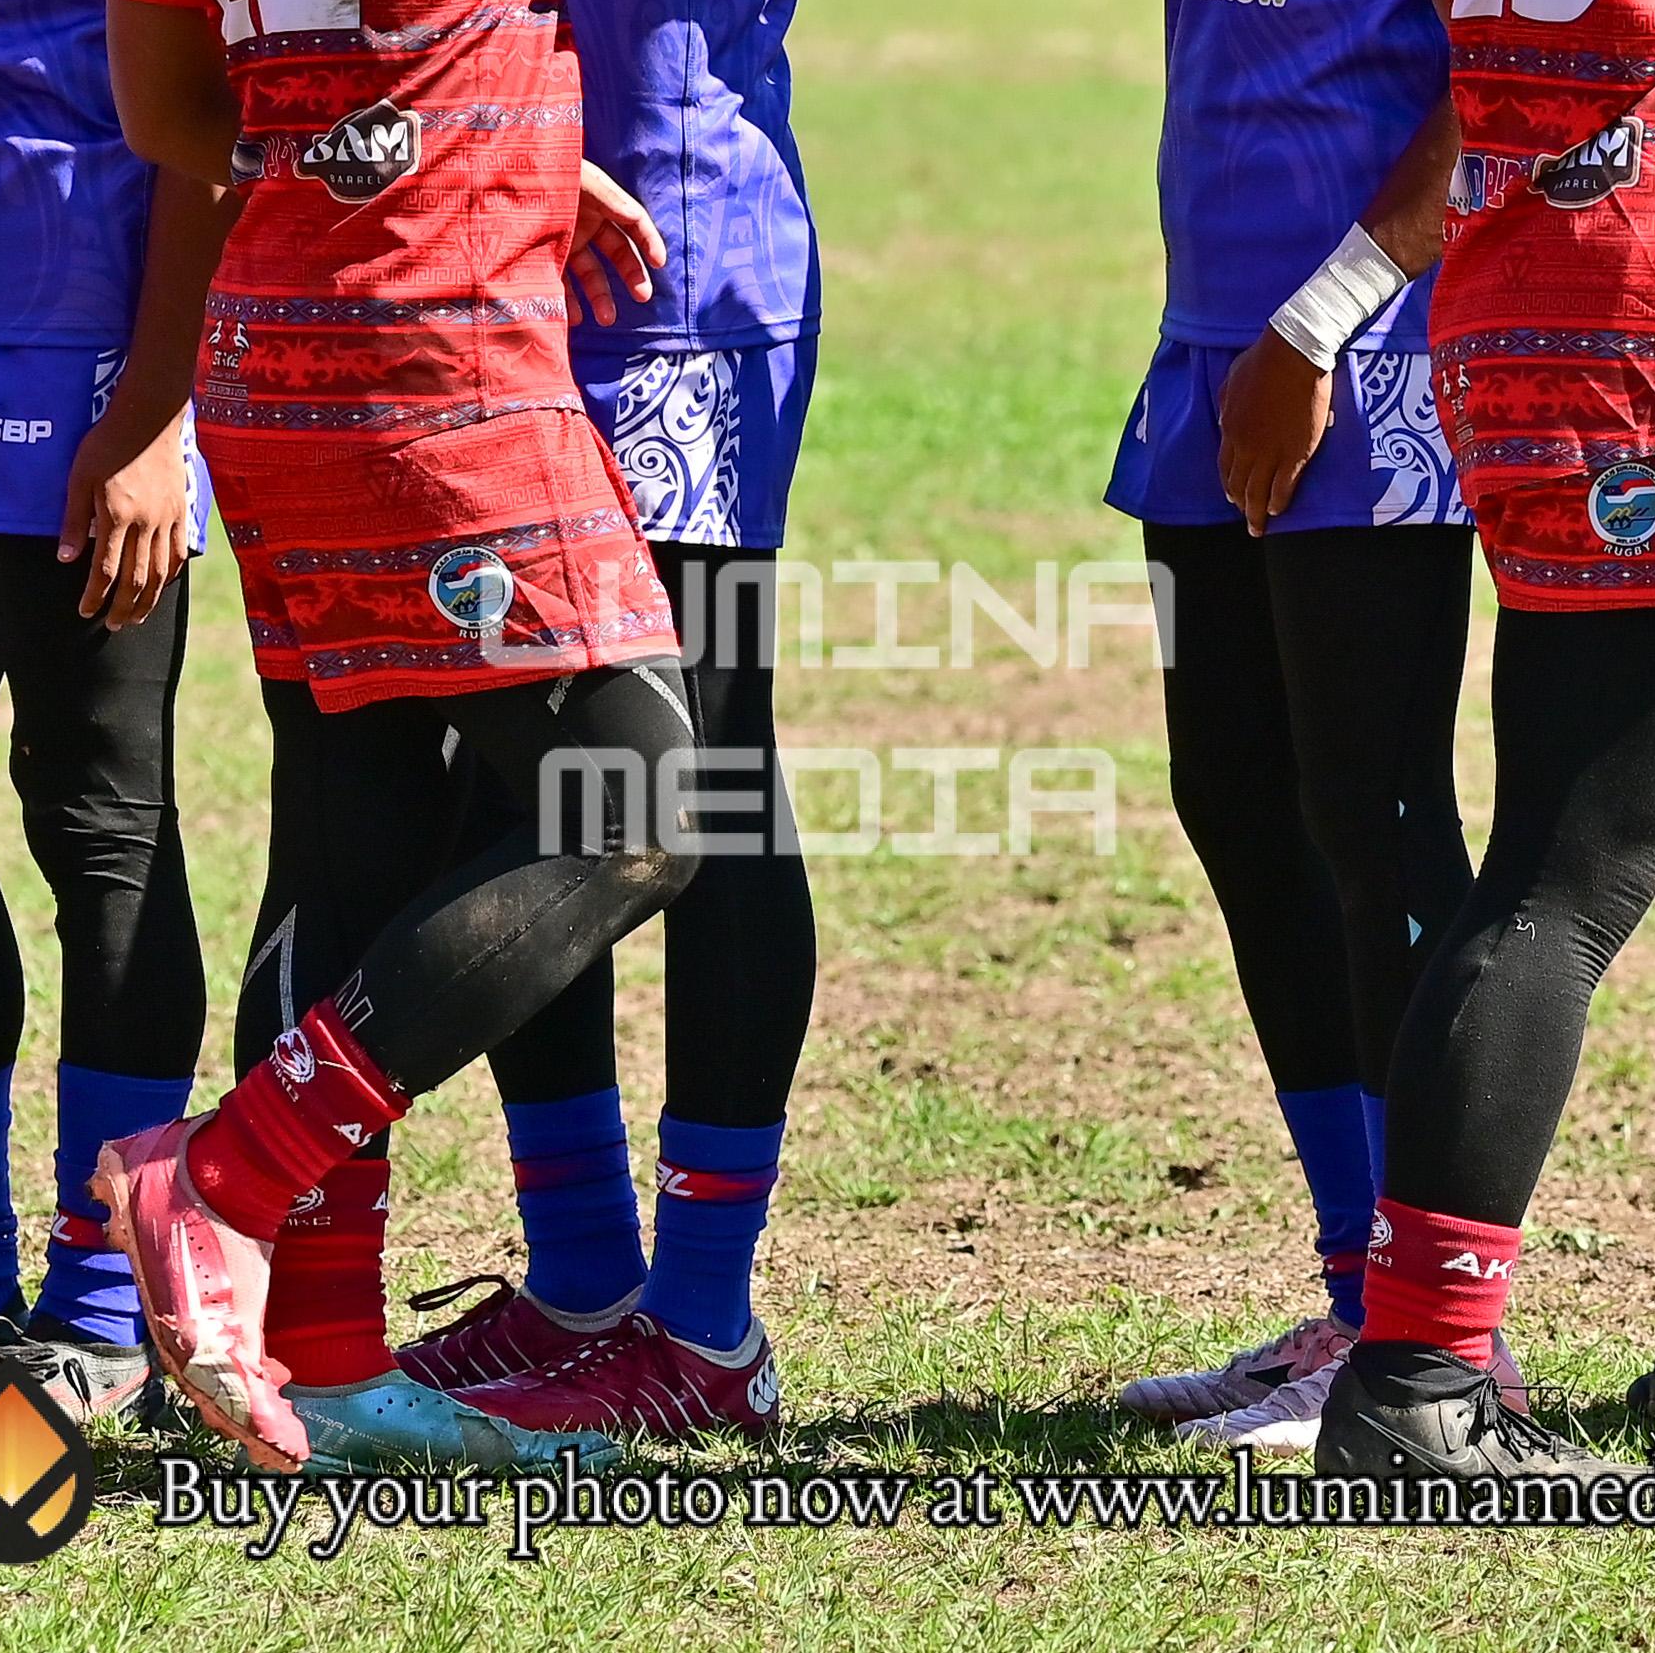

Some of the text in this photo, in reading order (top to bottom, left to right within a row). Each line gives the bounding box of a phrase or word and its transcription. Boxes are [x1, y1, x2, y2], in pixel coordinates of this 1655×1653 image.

[330, 174, 382, 186] BARREL
[1603, 541, 1651, 557] RUGBY
[295, 1406, 345, 1430] ULTRA
